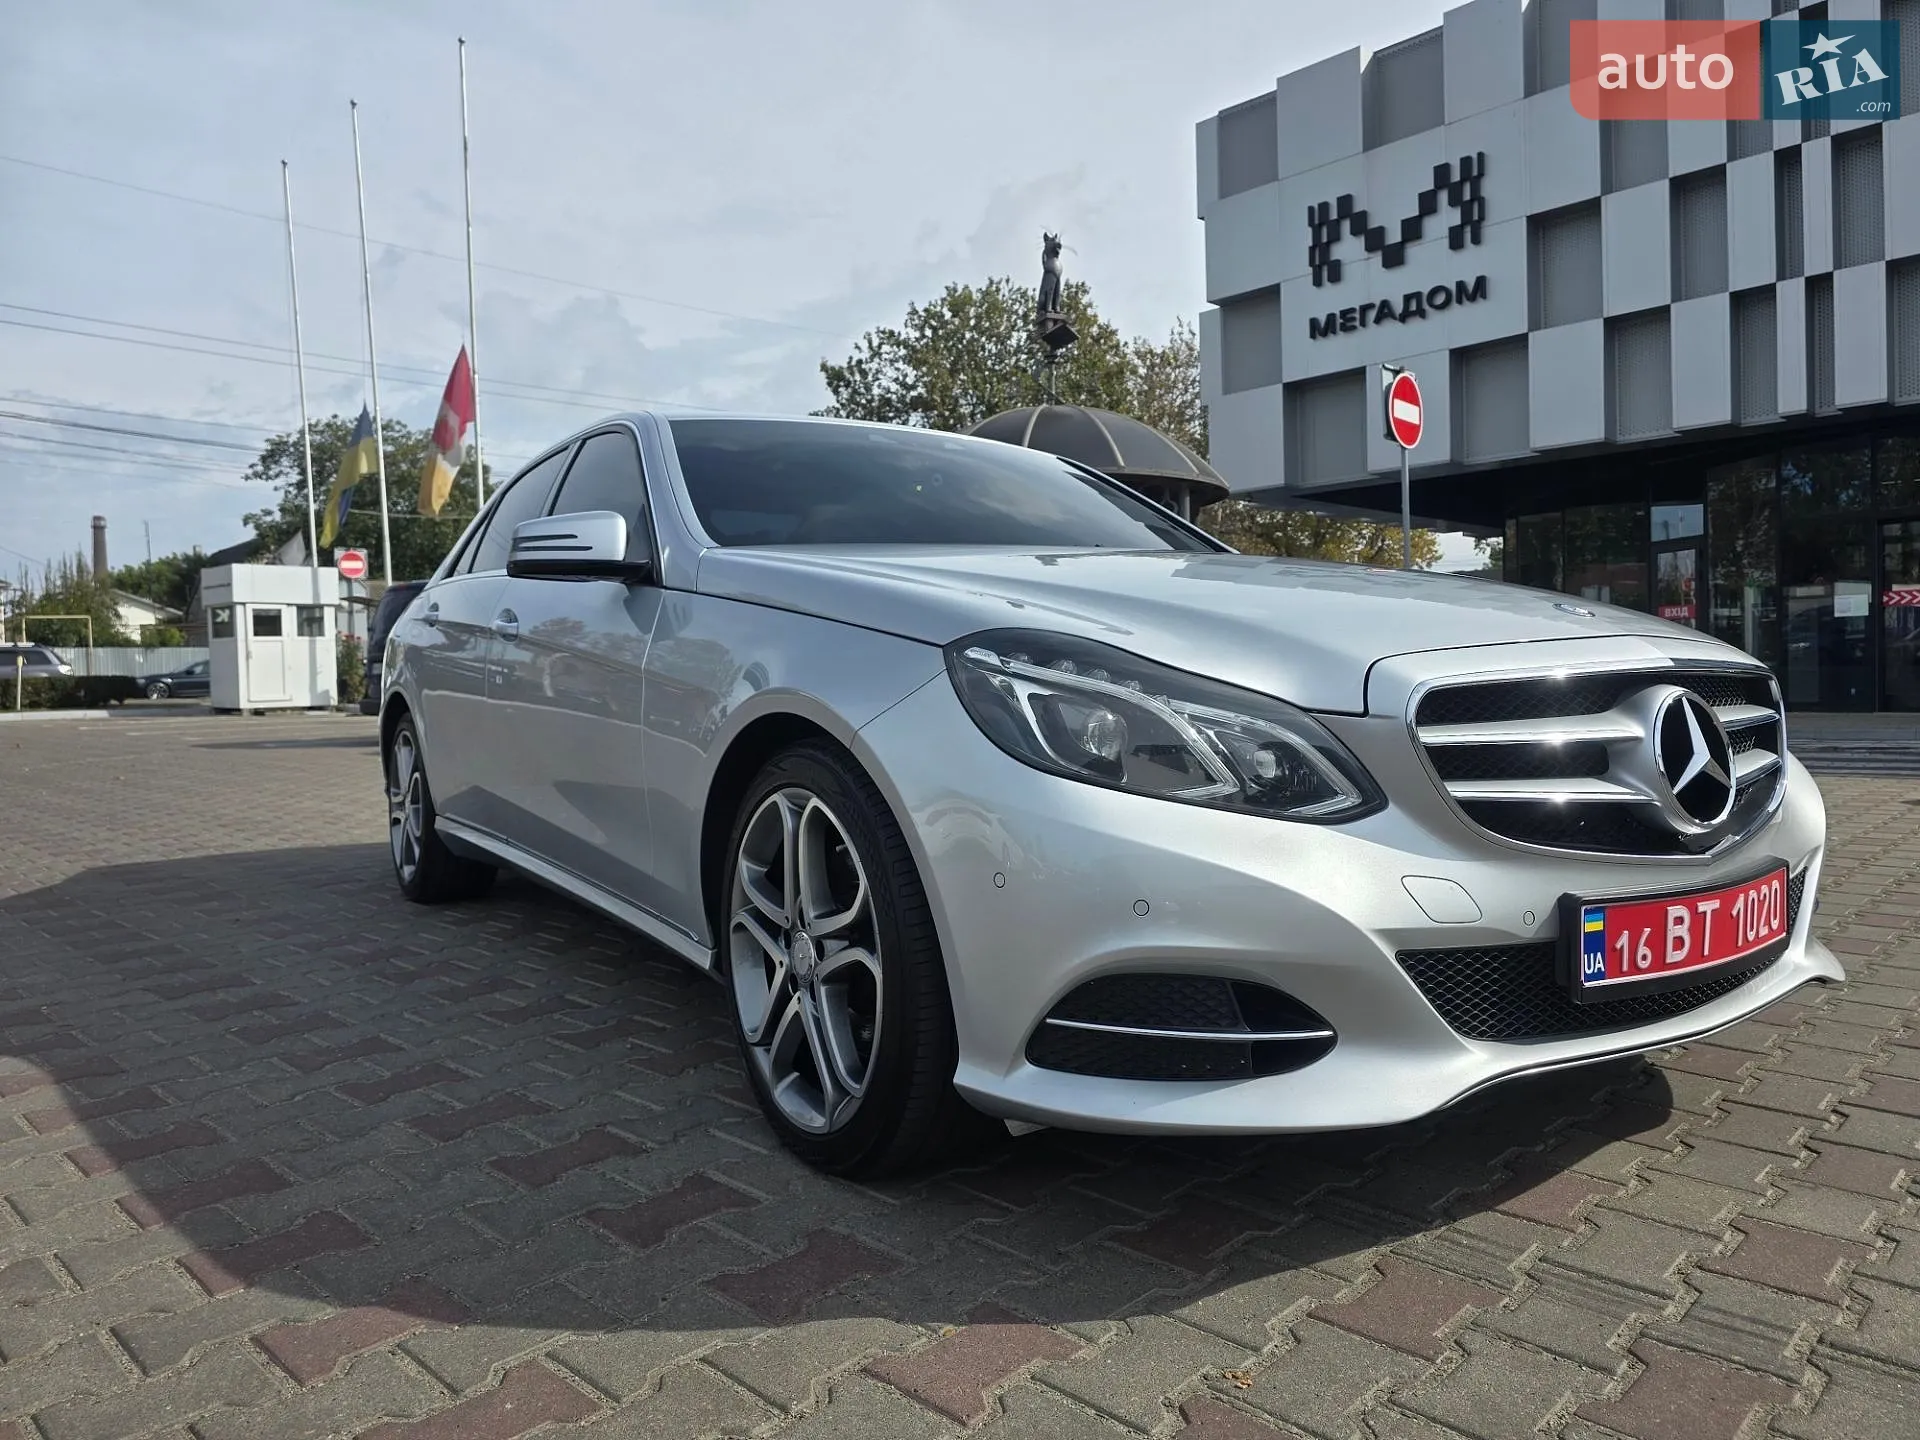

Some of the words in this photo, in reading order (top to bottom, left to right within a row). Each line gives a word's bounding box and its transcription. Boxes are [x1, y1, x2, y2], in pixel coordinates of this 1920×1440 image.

[1309, 275, 1487, 340] МЕГАДОМ
[1614, 927, 1652, 973] 16
[1665, 899, 1720, 963] BT
[1730, 879, 1781, 947] 1020
[1584, 951, 1605, 974] UA
